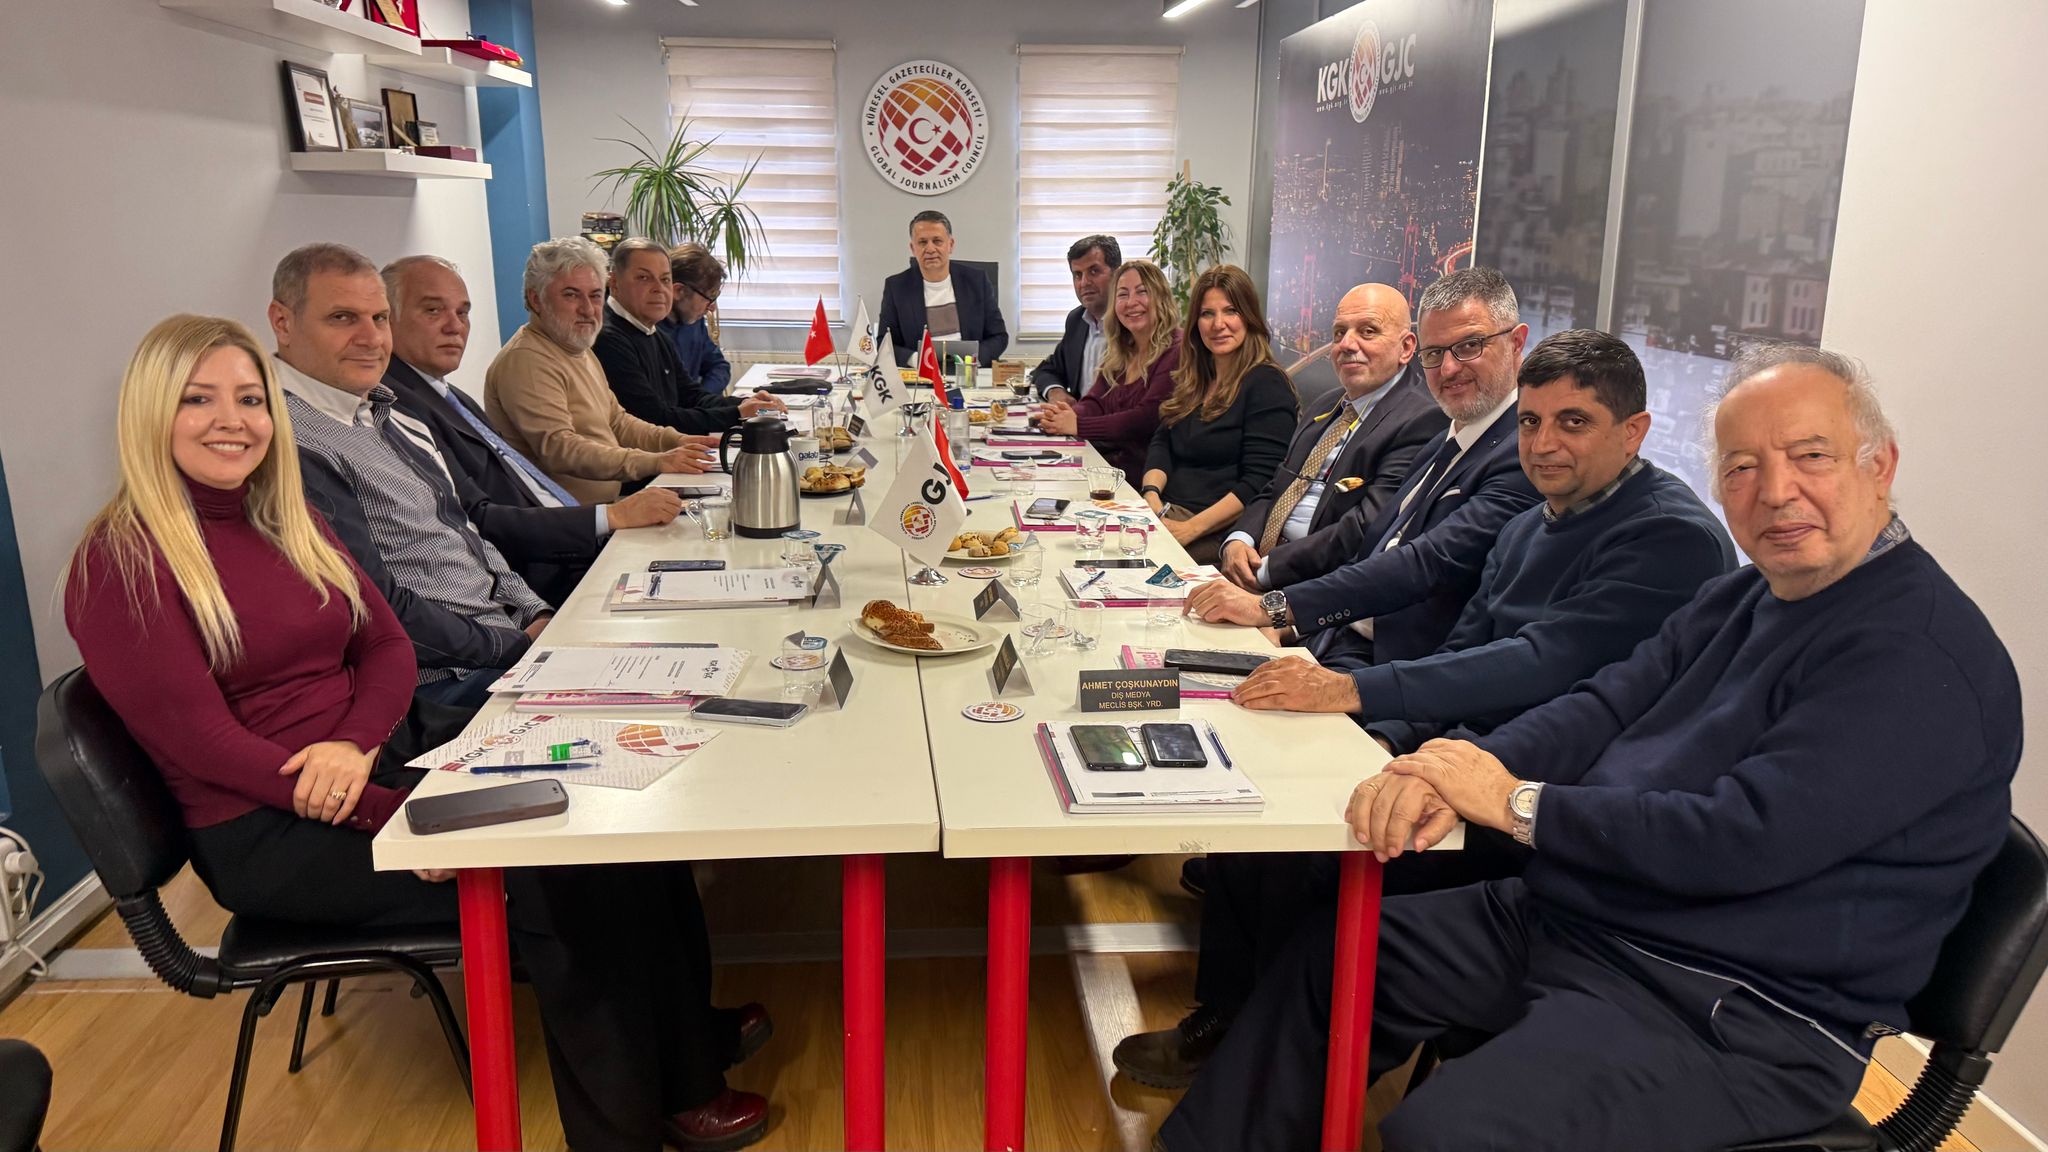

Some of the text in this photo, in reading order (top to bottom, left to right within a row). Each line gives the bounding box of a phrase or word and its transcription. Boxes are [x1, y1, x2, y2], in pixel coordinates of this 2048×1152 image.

[1317, 58, 1349, 103] KGK
[1381, 33, 1416, 84] GJC
[865, 63, 985, 126] KÜRESEL GAZETECİLER KONSEYİ
[870, 134, 985, 190] GLOBAL JOURNALISM COUNCIL
[870, 365, 893, 405] KGK
[1082, 681, 1112, 690] AHMET
[1099, 701, 1127, 709] MECLİS
[1111, 691, 1151, 700] DIŞ MEDYA
[455, 721, 541, 763] KGK GJC
